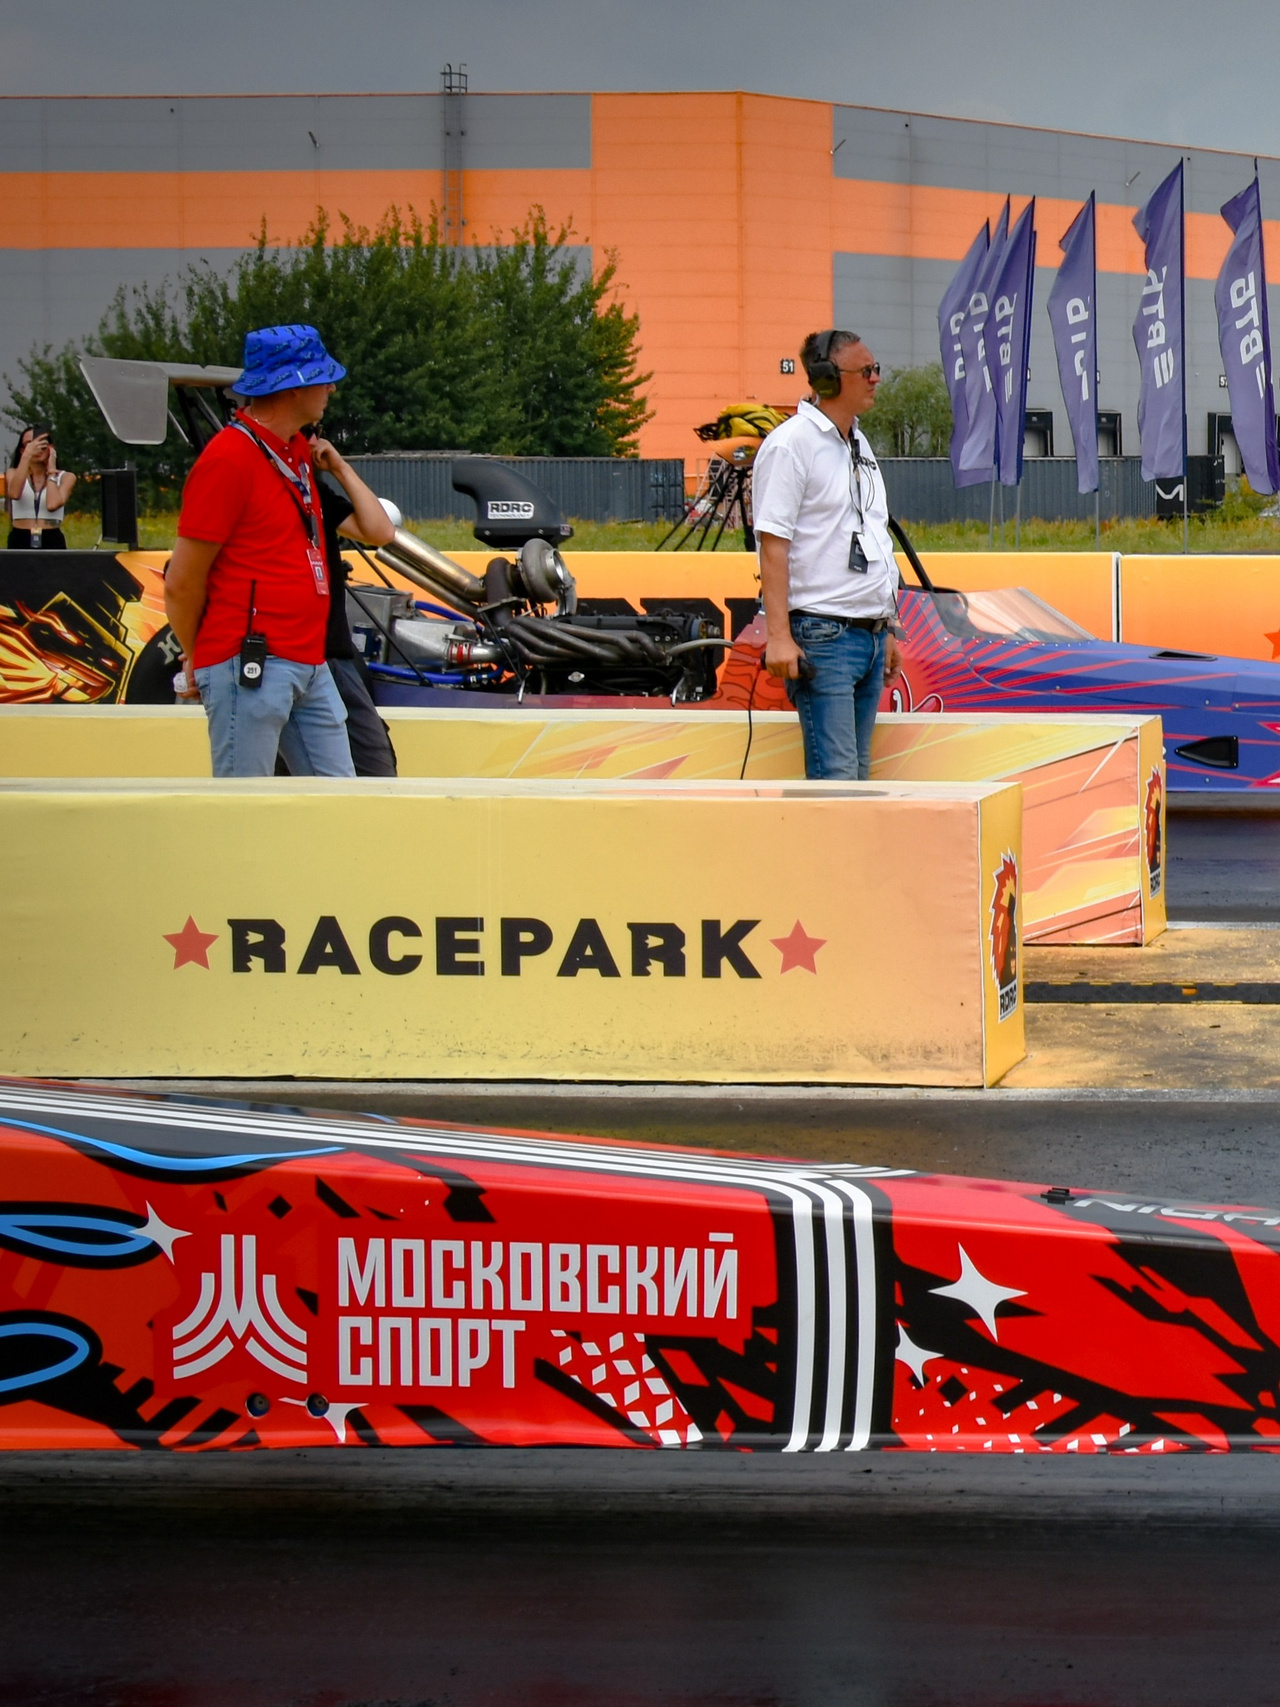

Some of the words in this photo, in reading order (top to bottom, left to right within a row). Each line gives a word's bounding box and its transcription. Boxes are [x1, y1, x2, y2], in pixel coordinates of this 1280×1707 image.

[782, 361, 794, 373] 51
[490, 502, 532, 513] RDRC
[246, 666, 258, 674] 251
[226, 915, 763, 980] RACEPARK
[338, 1232, 738, 1320] МОСКОВСКИЙ
[338, 1315, 526, 1388] СПОРТ
